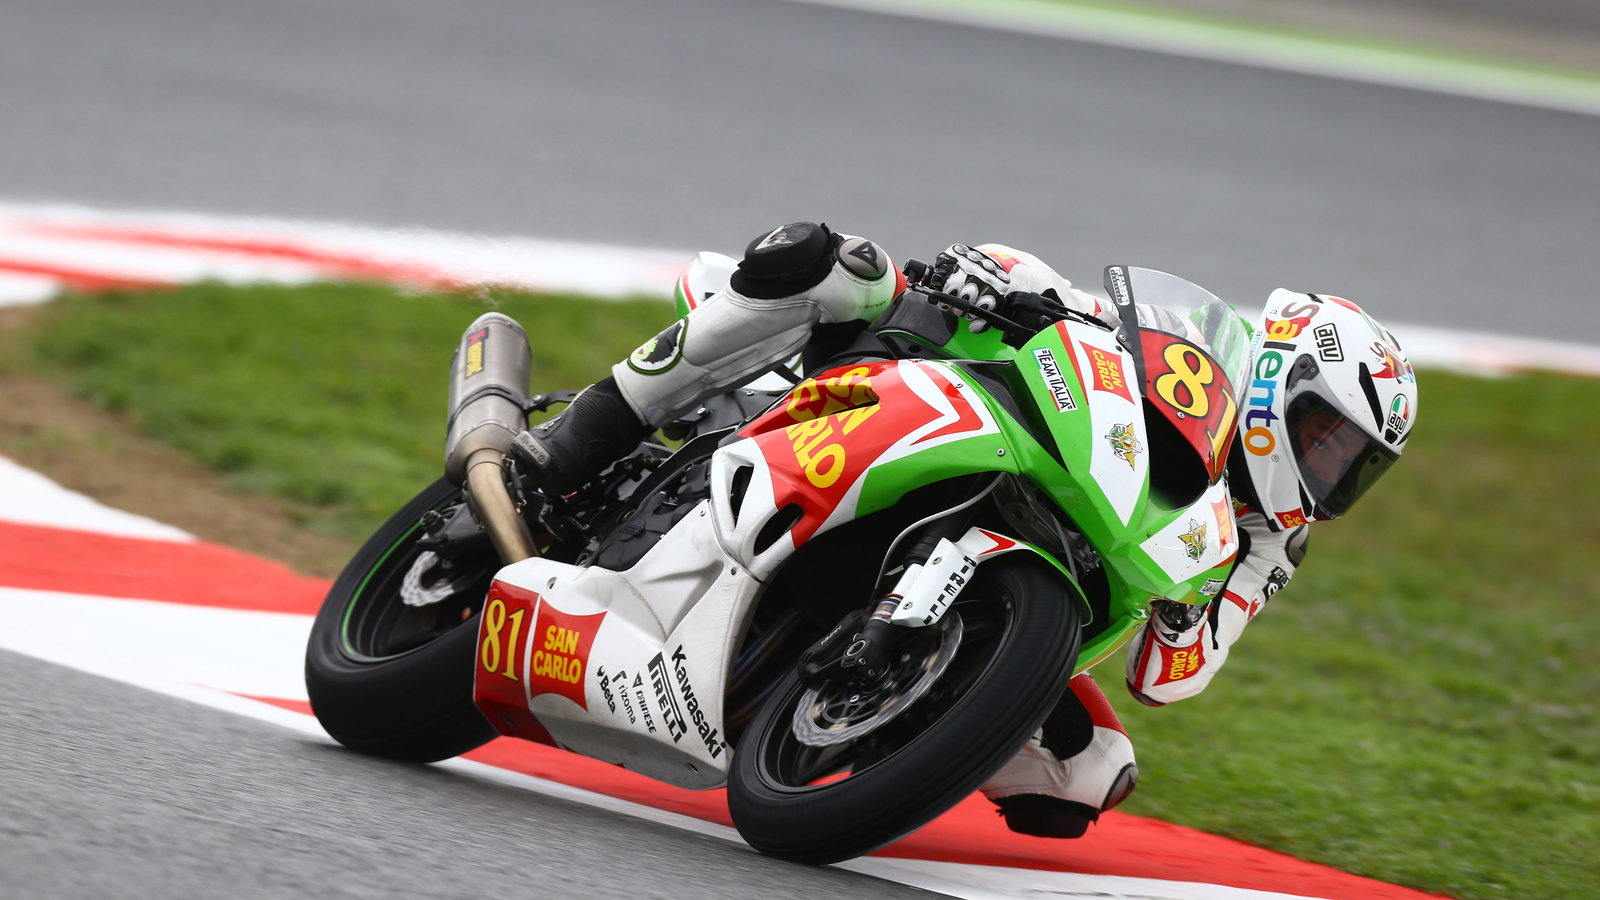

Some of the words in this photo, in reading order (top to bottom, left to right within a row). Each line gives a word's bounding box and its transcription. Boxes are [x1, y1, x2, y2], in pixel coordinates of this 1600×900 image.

[1316, 327, 1340, 359] agv
[1091, 349, 1115, 391] CARLO
[1106, 360, 1124, 389] SAN
[1244, 302, 1320, 457] Salento
[1153, 342, 1238, 475] 81
[923, 555, 977, 626] PIRELLI
[481, 599, 525, 682] 81
[544, 625, 580, 655] SAN
[1187, 647, 1199, 673] SAN
[533, 651, 582, 684] CARLO
[1168, 651, 1187, 680] CARLO
[600, 675, 616, 714] Beta
[619, 684, 636, 724] rizoma
[647, 651, 687, 743] PIRELLI
[671, 644, 727, 759] Kawasaki
